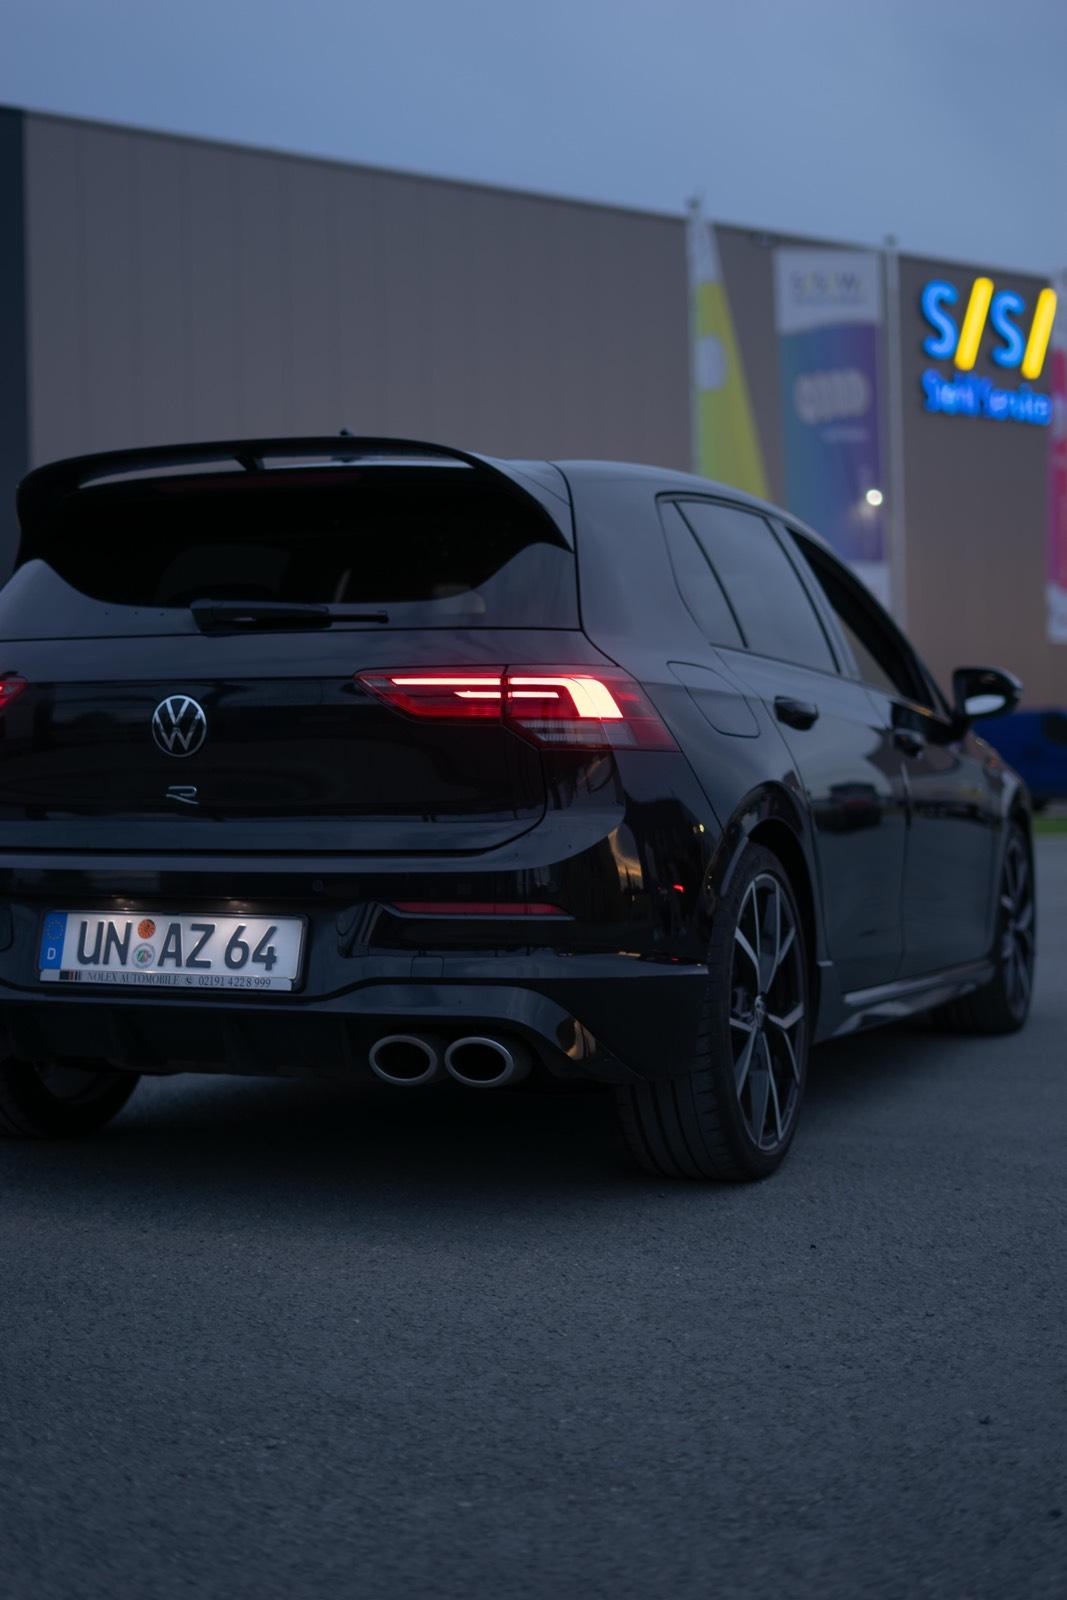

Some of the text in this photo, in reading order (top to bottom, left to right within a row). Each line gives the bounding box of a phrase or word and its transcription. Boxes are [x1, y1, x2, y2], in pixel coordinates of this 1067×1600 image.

[77, 921, 278, 971] UN AZ 64
[47, 947, 56, 960] D
[119, 972, 179, 985] AUTOMOBILE
